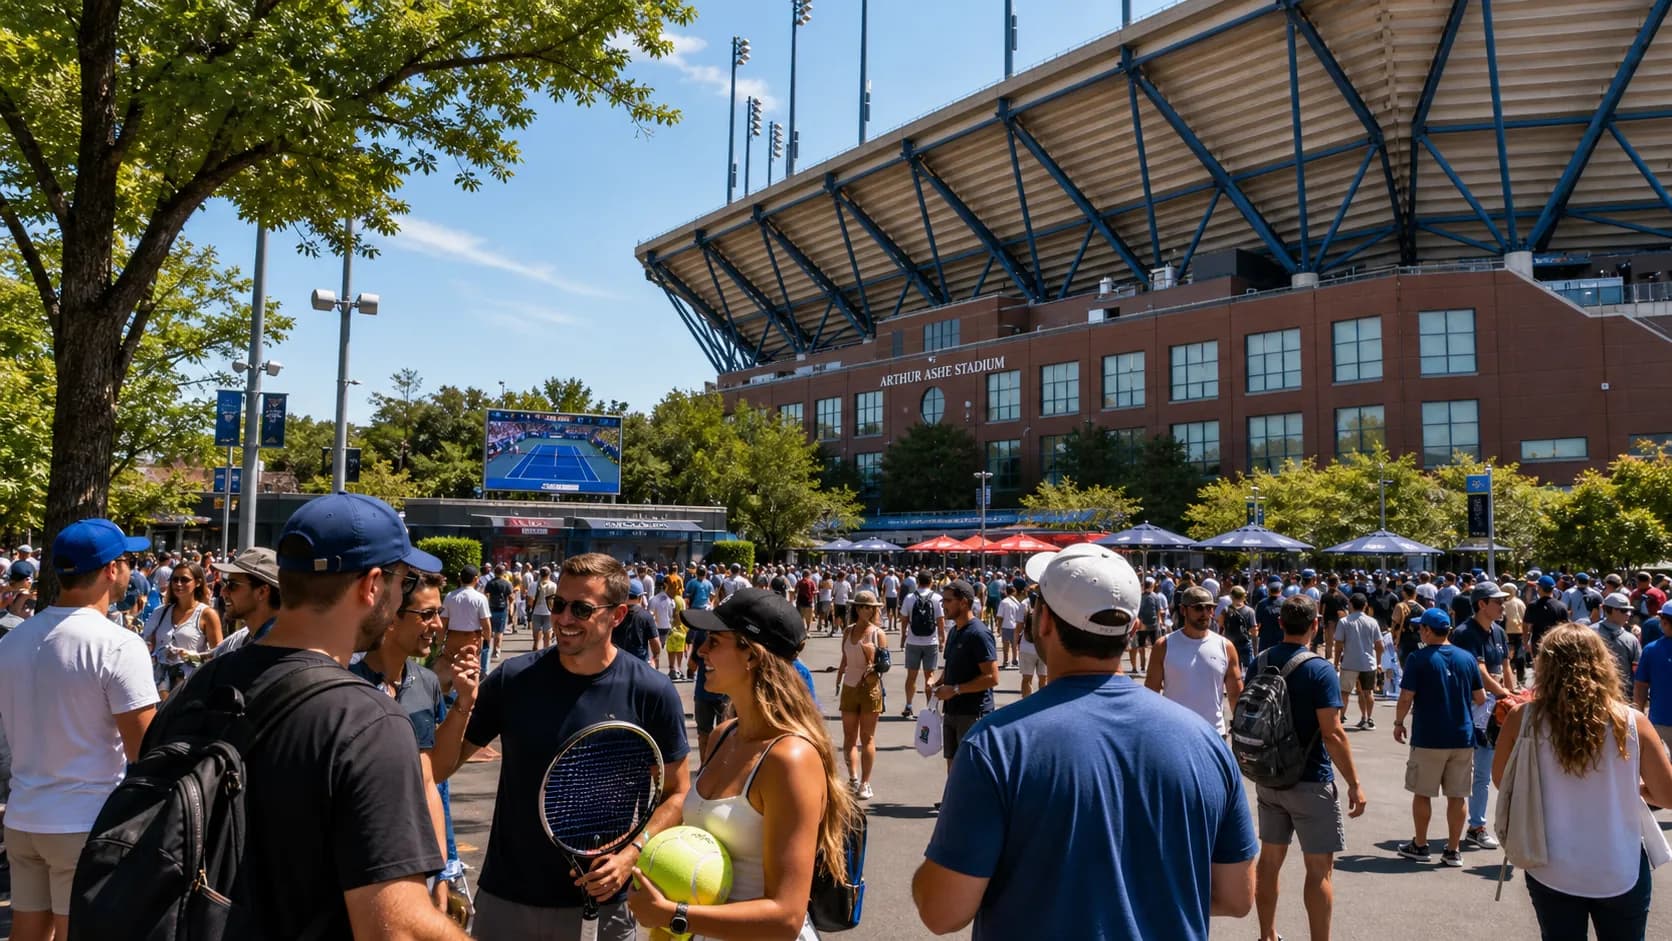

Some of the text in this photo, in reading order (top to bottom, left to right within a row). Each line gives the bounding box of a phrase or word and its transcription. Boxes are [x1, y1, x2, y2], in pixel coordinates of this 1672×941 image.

[880, 356, 1005, 387] ARTHUR ASHE STADIUM
